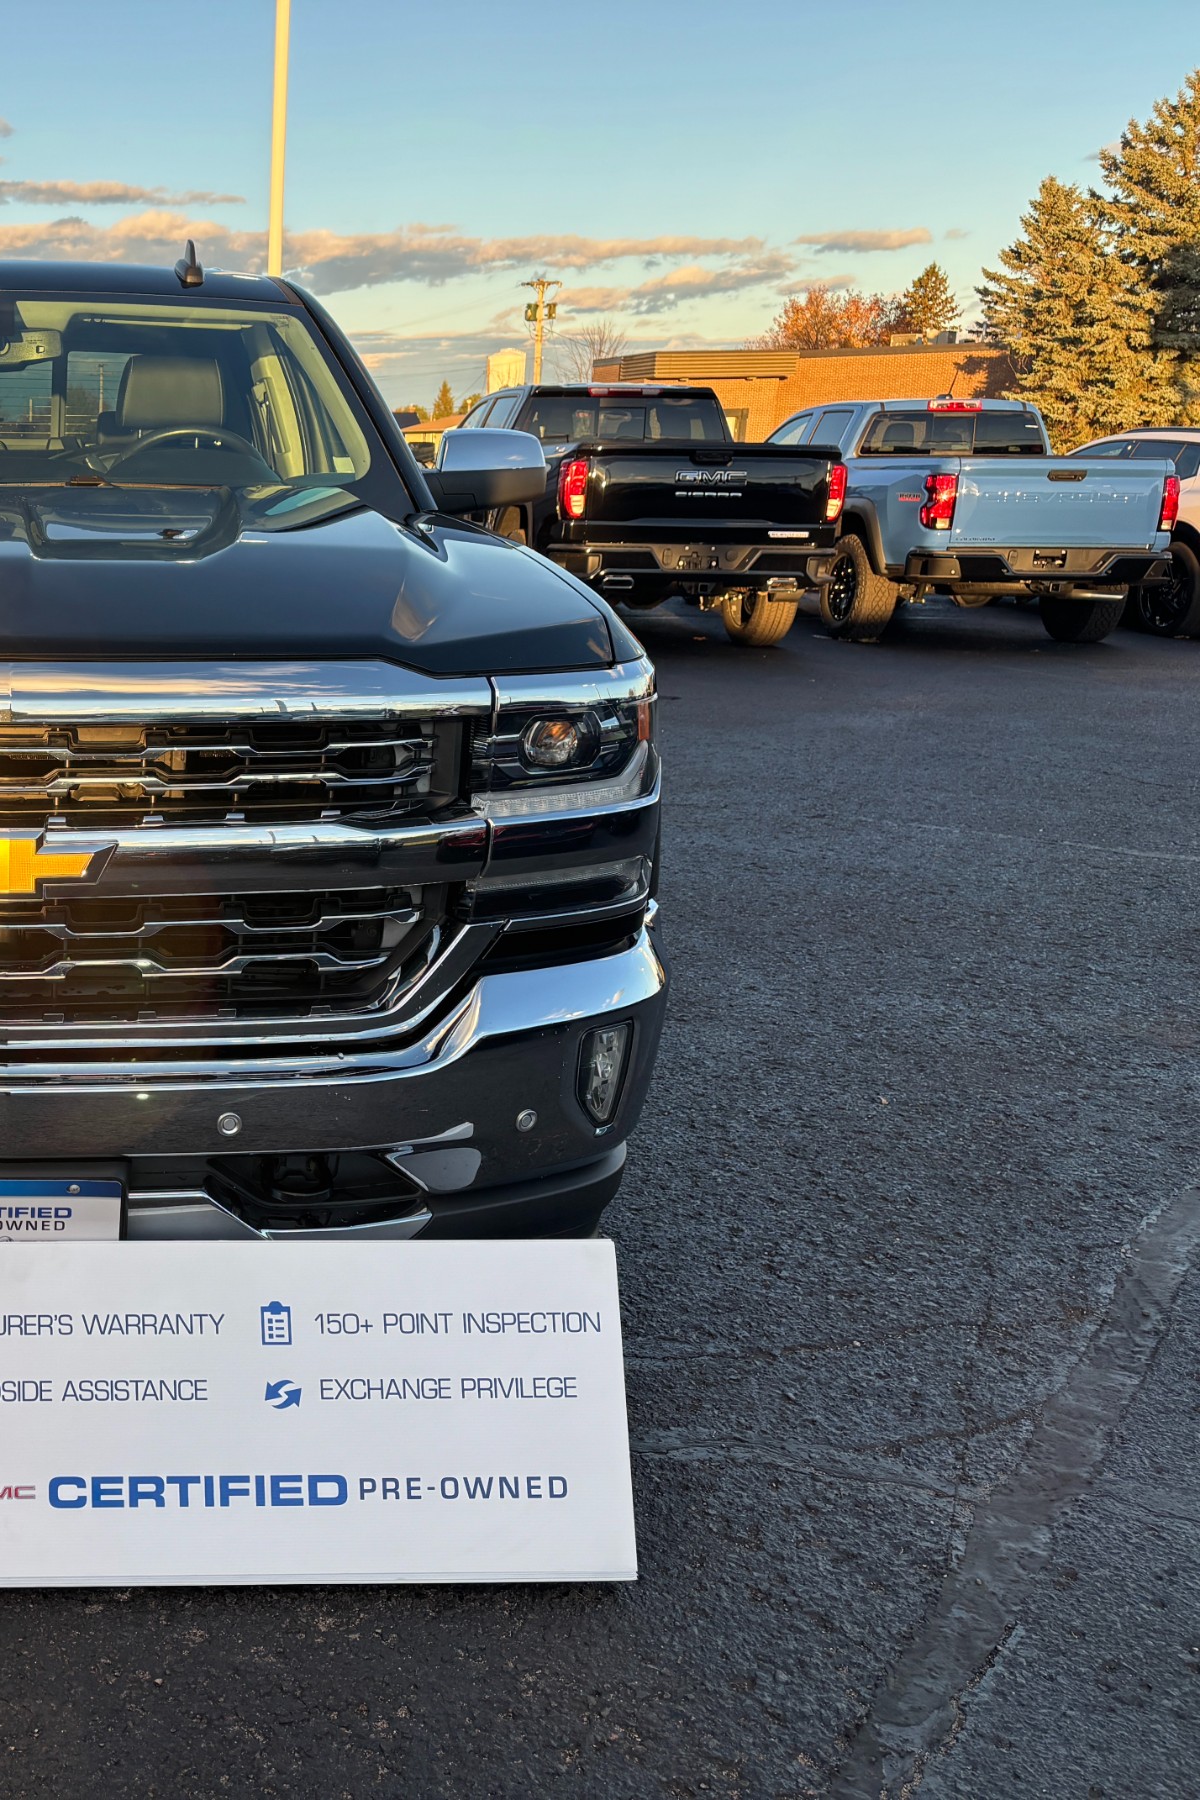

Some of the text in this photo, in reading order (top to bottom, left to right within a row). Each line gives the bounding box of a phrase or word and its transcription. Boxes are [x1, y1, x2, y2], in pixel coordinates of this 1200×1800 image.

[675, 470, 748, 486] GMC
[81, 1313, 225, 1336] WARRANTY
[314, 1311, 601, 1335] 150+ POINT INSPECTION
[61, 1379, 208, 1402] ASSISTANCE
[319, 1377, 578, 1401] EXCHANGE PRIVILEGE
[48, 1475, 348, 1508] CERTIFIED
[359, 1475, 568, 1501] PRE-OWNED
